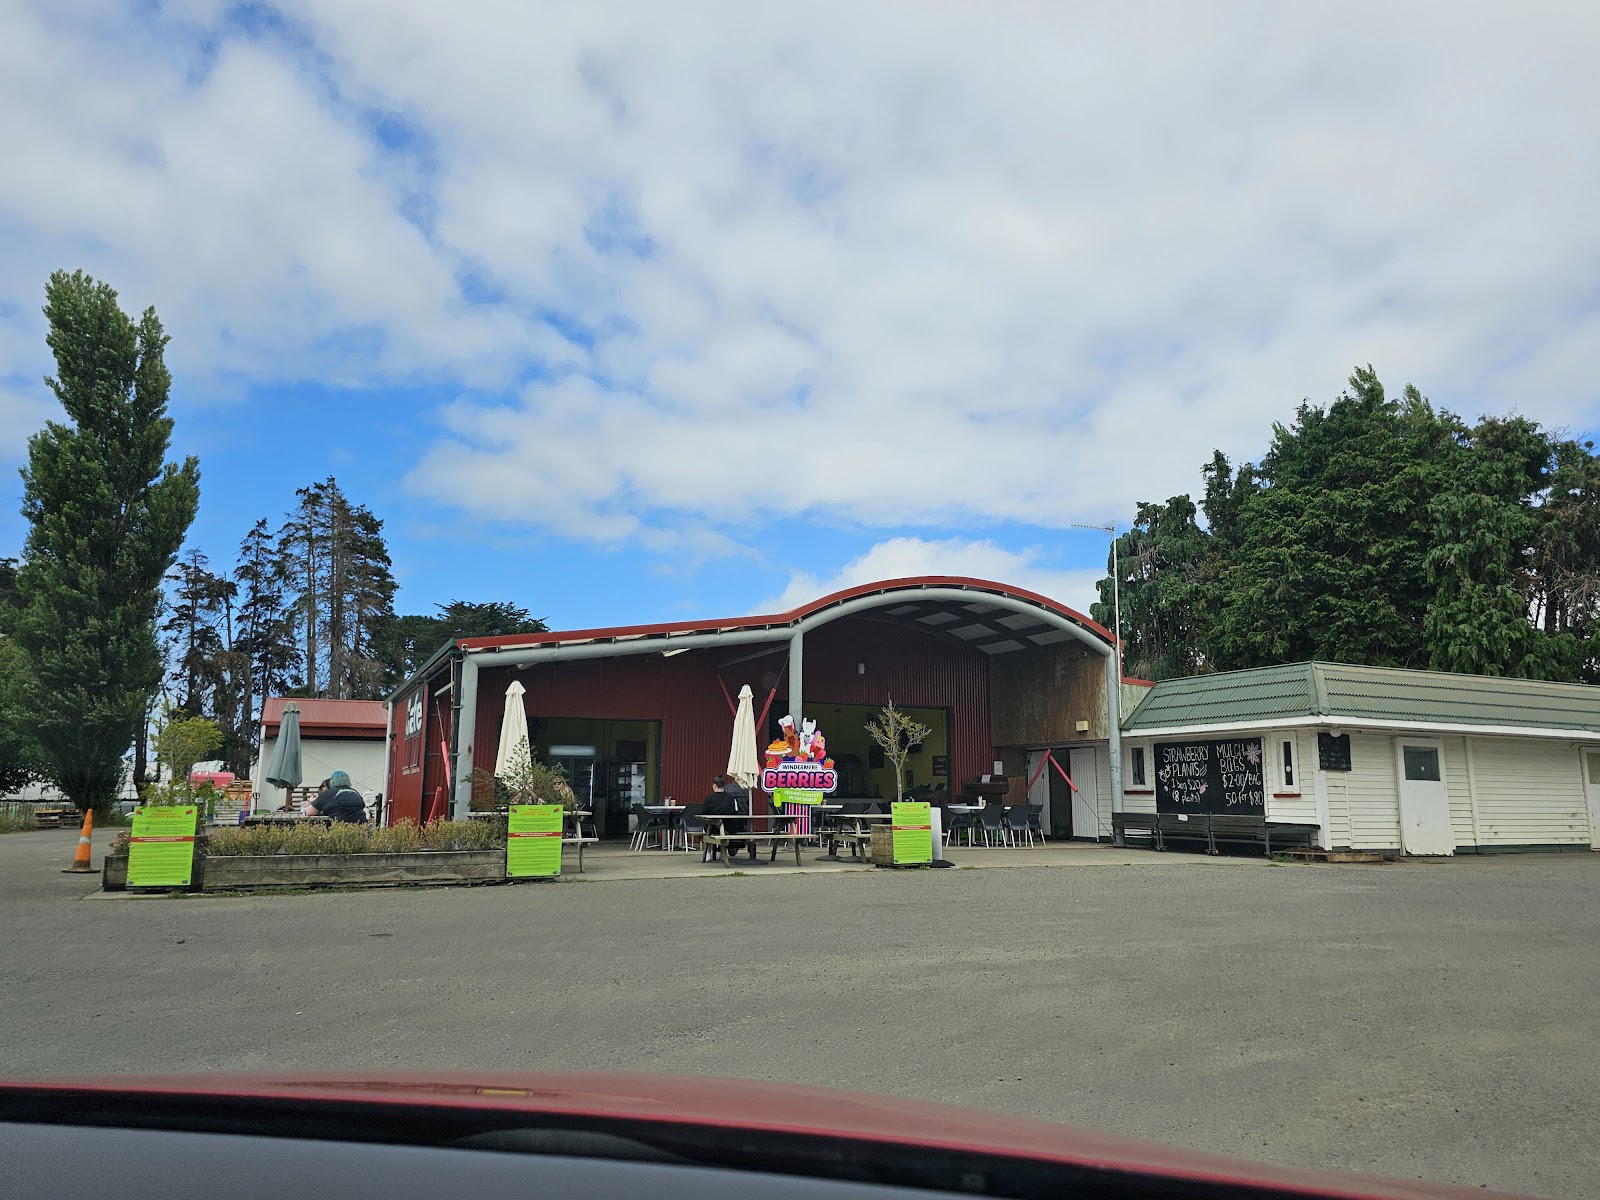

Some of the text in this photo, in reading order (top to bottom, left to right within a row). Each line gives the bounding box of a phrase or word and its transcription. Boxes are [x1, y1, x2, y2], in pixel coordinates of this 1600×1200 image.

[1163, 745, 1209, 763] STRAWBERRY
[1216, 743, 1245, 759] MULCH
[1172, 762, 1200, 777] PLANTS
[1220, 757, 1245, 773] BAGS
[765, 771, 834, 788] BERRIES
[1225, 791, 1237, 806] 50
[1249, 790, 1264, 806] $80
